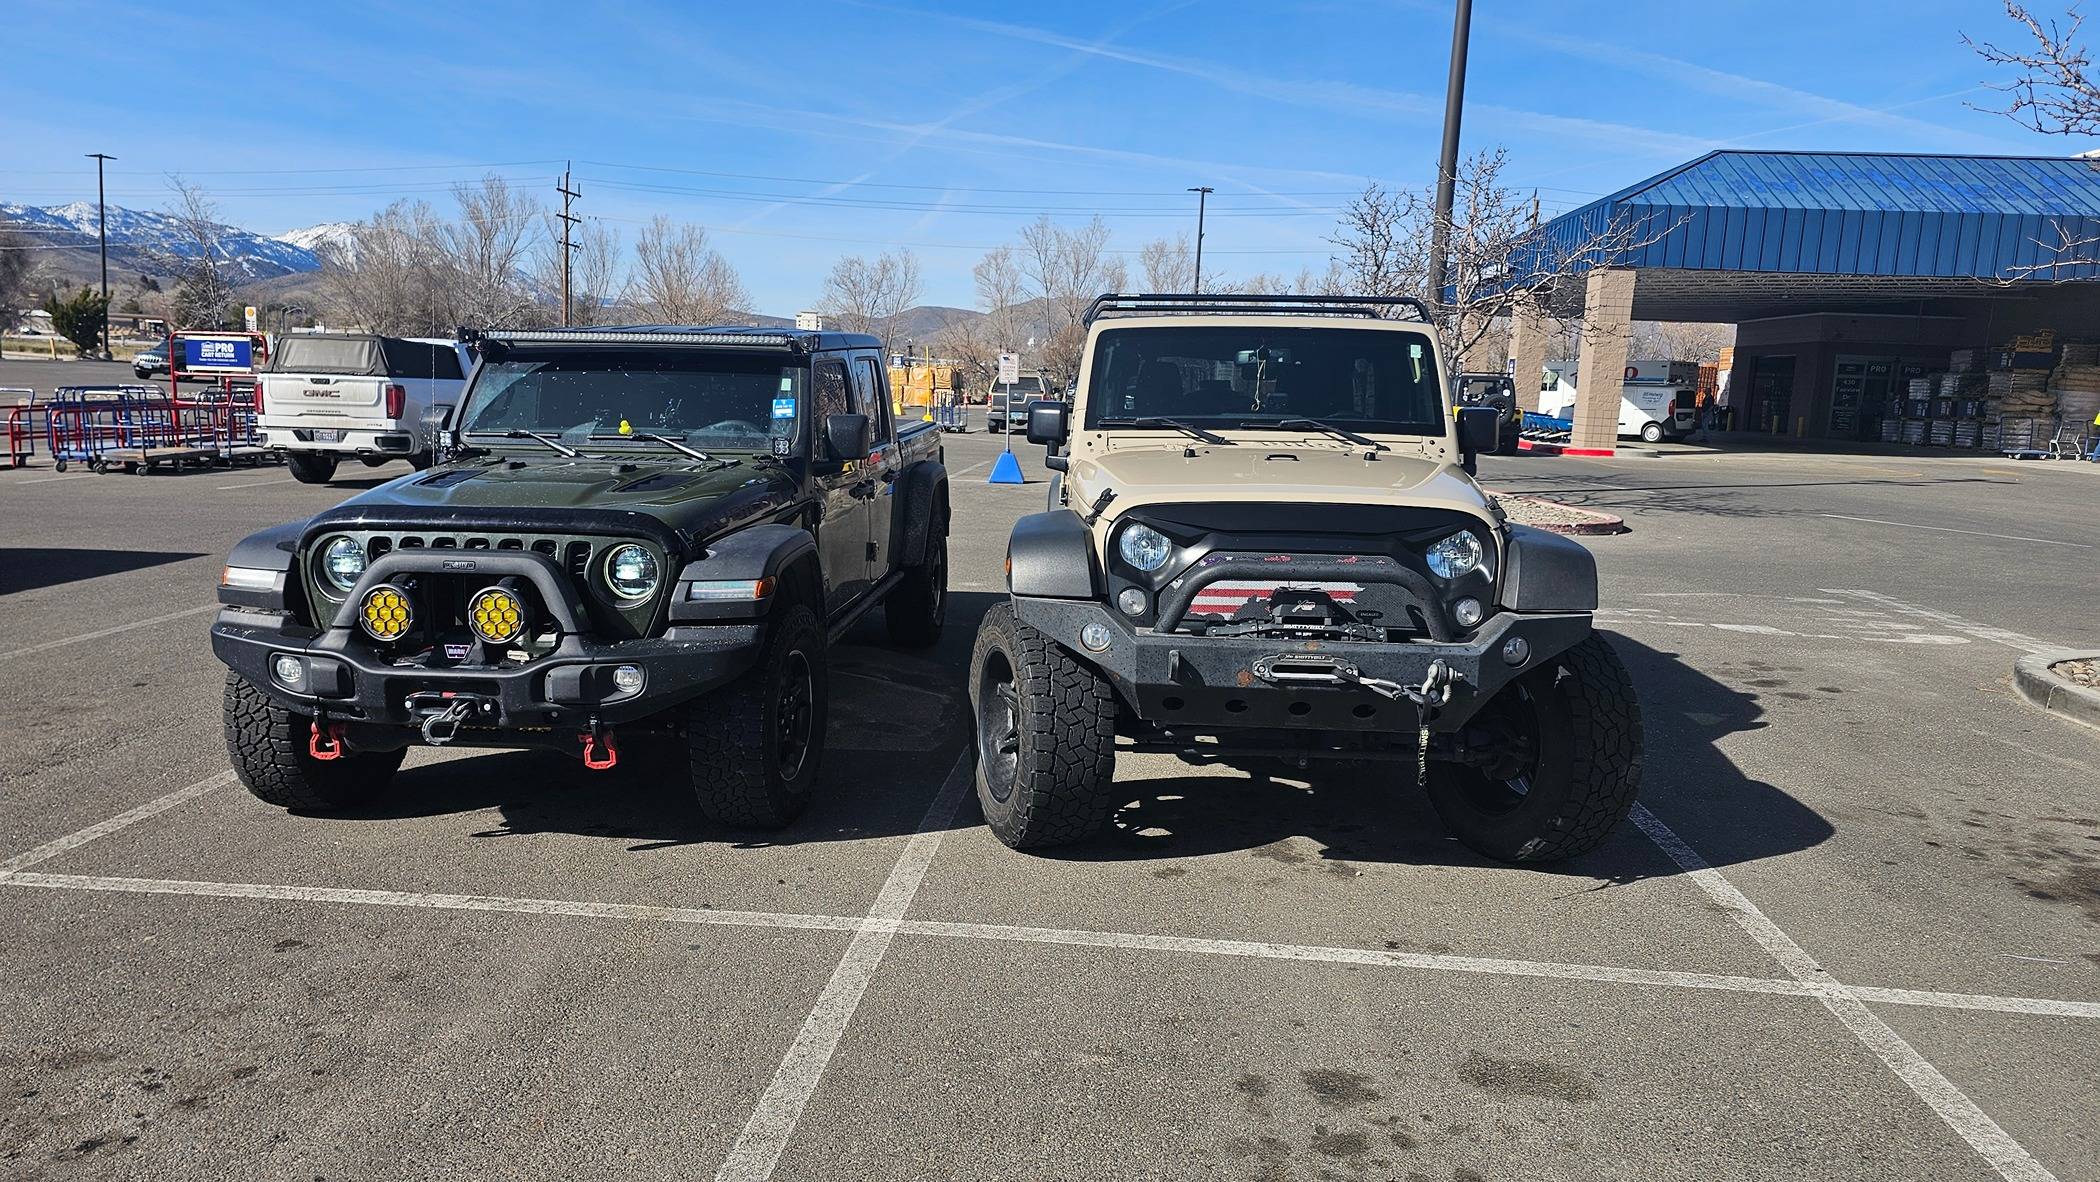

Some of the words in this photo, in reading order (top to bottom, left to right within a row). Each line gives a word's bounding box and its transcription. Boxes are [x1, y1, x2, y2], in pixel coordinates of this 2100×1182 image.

[215, 342, 234, 352] PRO
[1870, 365, 1887, 373] PRO
[303, 389, 340, 397] GMC
